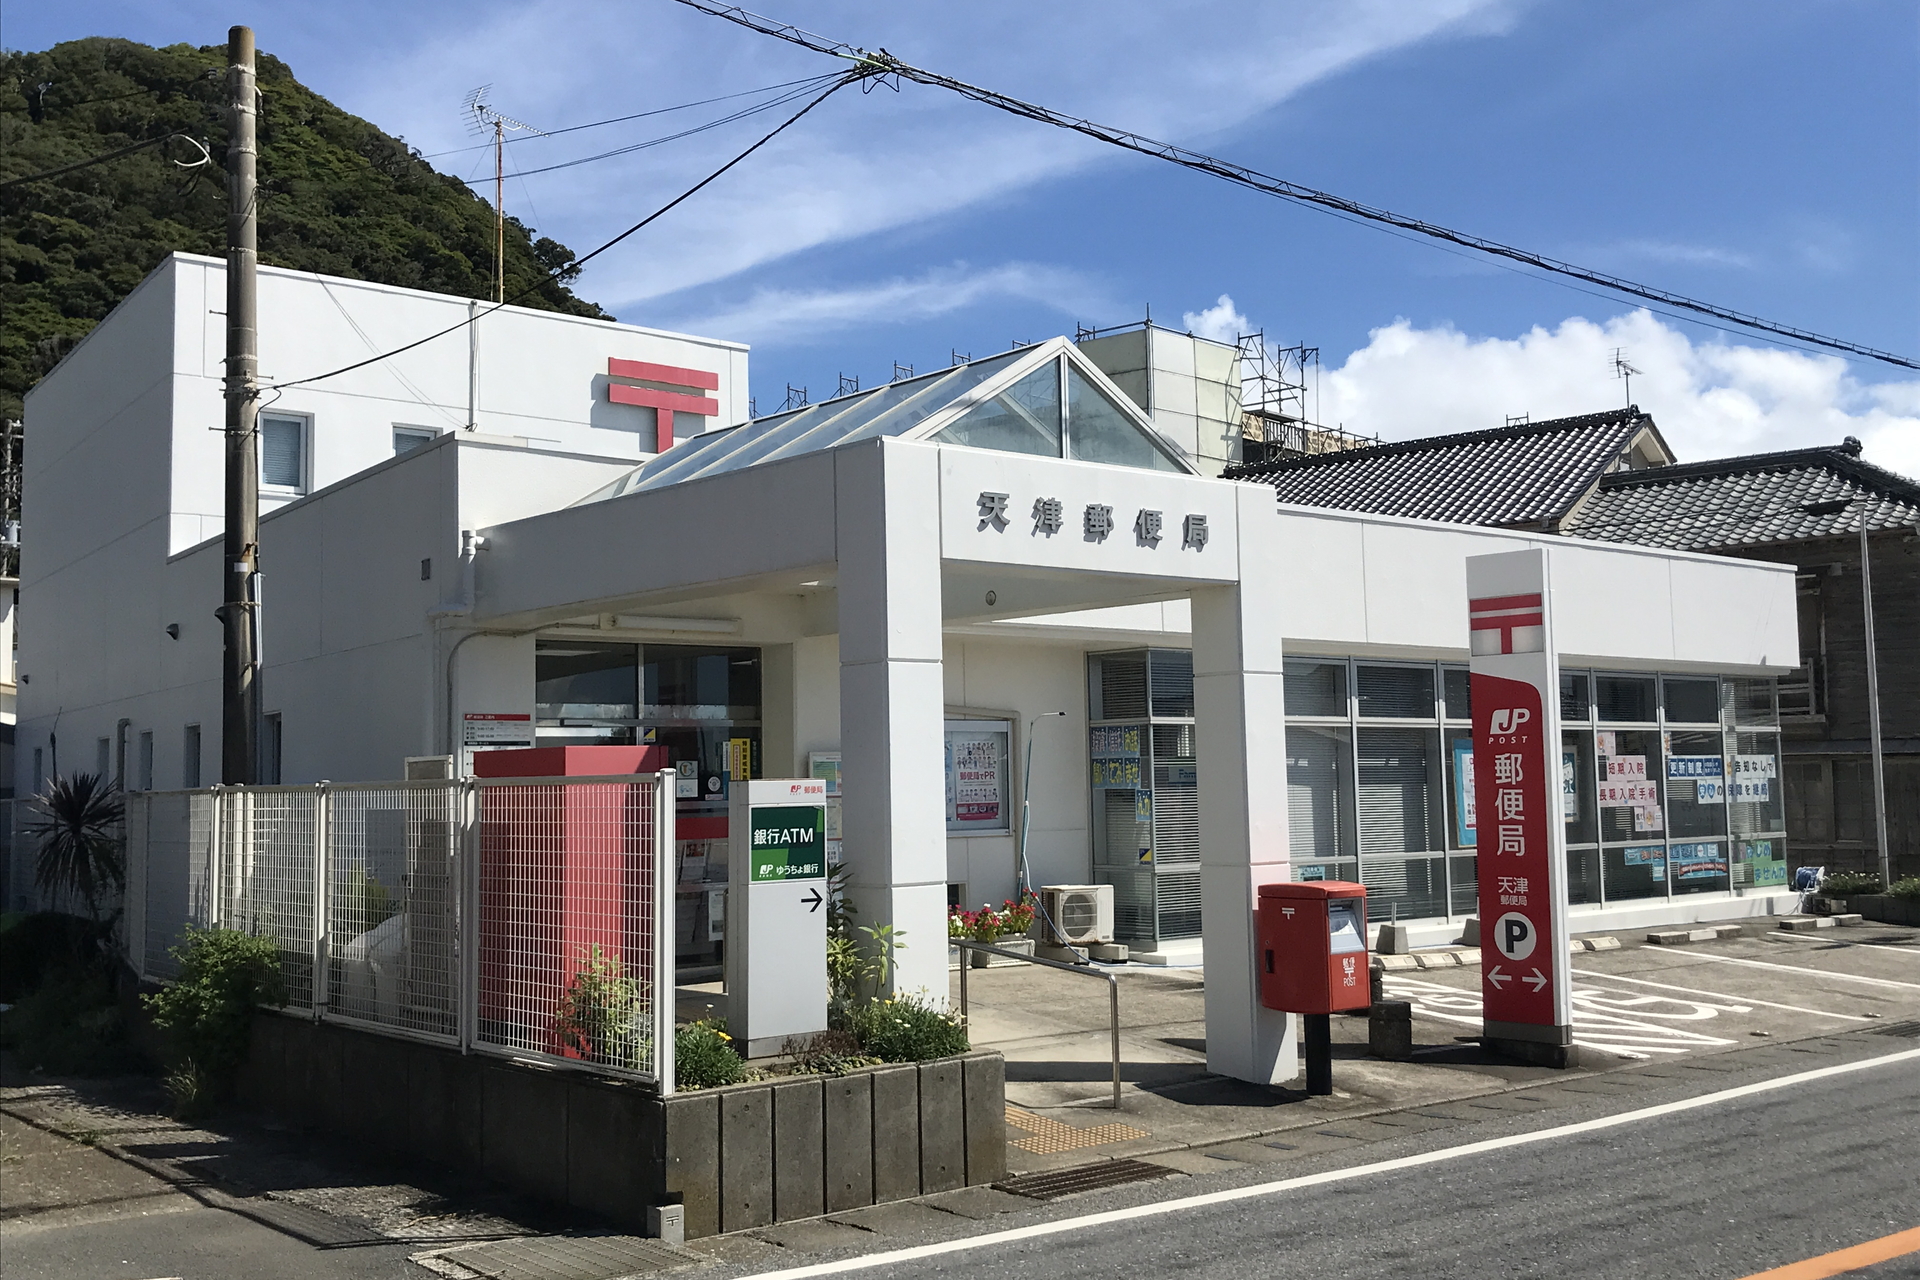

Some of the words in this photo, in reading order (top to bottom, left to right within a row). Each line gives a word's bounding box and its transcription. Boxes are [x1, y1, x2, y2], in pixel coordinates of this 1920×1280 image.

[977, 490, 1210, 550] 天津郵便局
[1488, 736, 1528, 745] POST
[1608, 762, 1645, 775] 短期入院
[959, 771, 995, 781] 郵便局でPR
[804, 785, 824, 795] 郵便局
[1599, 787, 1656, 801] 長期入院手術
[1494, 752, 1526, 858] 郵便局
[753, 828, 814, 846] 銀行ATM
[776, 863, 819, 876] ゆうちょ銀行
[1497, 876, 1529, 895] 天津
[1500, 894, 1528, 907] 郵便局
[1504, 918, 1529, 954] P
[1342, 956, 1356, 968] 郵便
[1343, 977, 1356, 987] POST
